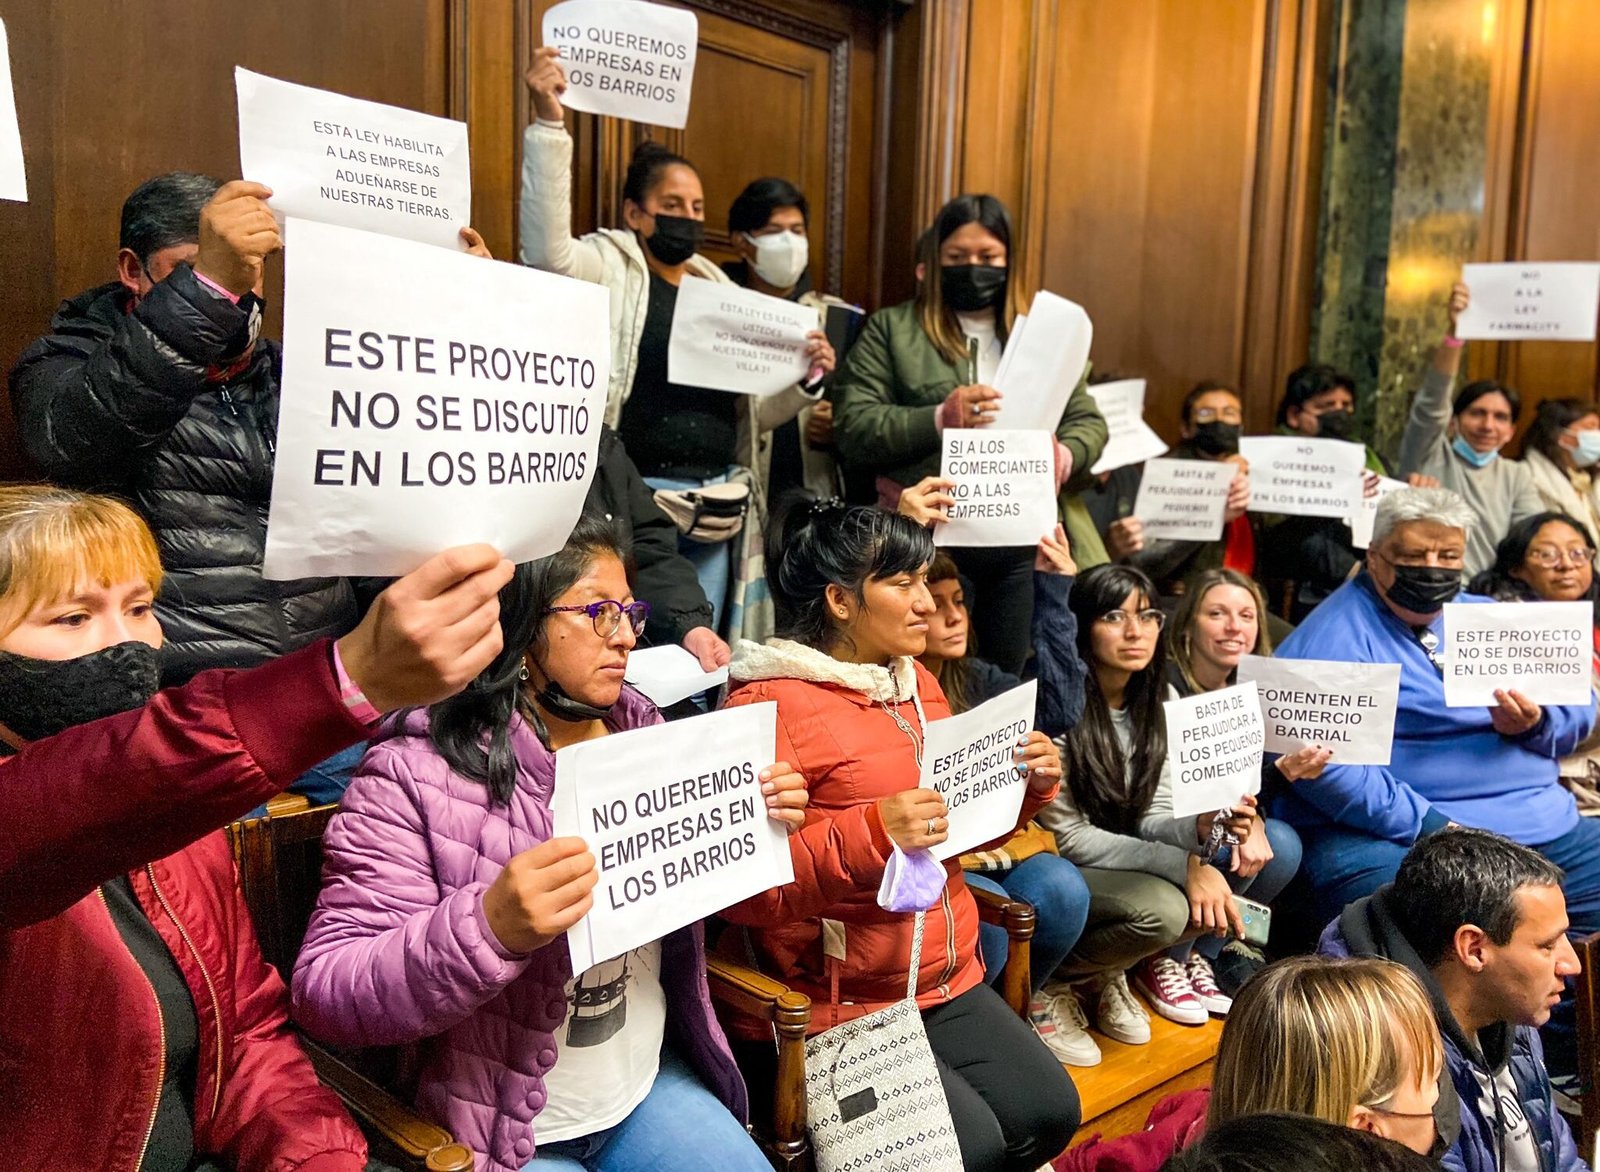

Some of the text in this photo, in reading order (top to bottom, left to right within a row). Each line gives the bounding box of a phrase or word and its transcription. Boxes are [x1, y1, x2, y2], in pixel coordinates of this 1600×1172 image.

[553, 26, 687, 60] NO QUEREMOS
[558, 45, 682, 82] EMPRESAS EN
[566, 70, 676, 103] OS BARRIOS
[313, 121, 444, 157] ESTA LEY HABILITA
[326, 145, 440, 178] A LAS EMPRESAS
[335, 169, 437, 199] ADUEÑARSE DE
[320, 186, 453, 221] NUESTRAS TIERRAS.
[720, 302, 744, 316] ESTA
[715, 331, 729, 341] NO
[742, 323, 782, 338] USTEDES
[325, 328, 595, 390] ESTE PROYECTO
[712, 344, 793, 364] NUESTRAS TIERRAS
[736, 361, 759, 373] VILLA
[331, 390, 589, 436] NO SE DISCUTIÓ
[949, 440, 1005, 454] SI A LOS
[1296, 447, 1314, 456] NO
[314, 449, 587, 487] EN LOS BARRIOS
[948, 460, 1048, 475] COMERCIANTES
[1272, 461, 1336, 474] QUEREMOS
[973, 484, 982, 497] A
[986, 483, 1011, 497] LAS
[1272, 477, 1333, 490] EMPRESAS
[946, 502, 1020, 519] EMPRESAS
[1272, 495, 1295, 504] LOS
[1297, 496, 1350, 508] BARRIOS
[1456, 630, 1582, 642] ESTE PROYECTO
[1458, 644, 1579, 659] NO SE DISCUTIÓ
[1454, 663, 1581, 676] EN LOS BARRIOS
[1195, 695, 1245, 720] BASTA DE
[1357, 695, 1378, 708] EL
[1268, 707, 1362, 725] COMERCIO
[1182, 712, 1258, 744] PERJUDICAR A
[1275, 724, 1352, 742] BARRIAL
[933, 719, 1027, 775] ESTE PROYECTO
[1180, 730, 1262, 764] LOS PEQUEÑOS
[933, 744, 1014, 794] NO SE DISCUTI
[592, 762, 754, 833] NO QUEREMOS
[601, 796, 755, 872] EMPRESAS EN
[608, 832, 756, 911] LOS BARRIOS
